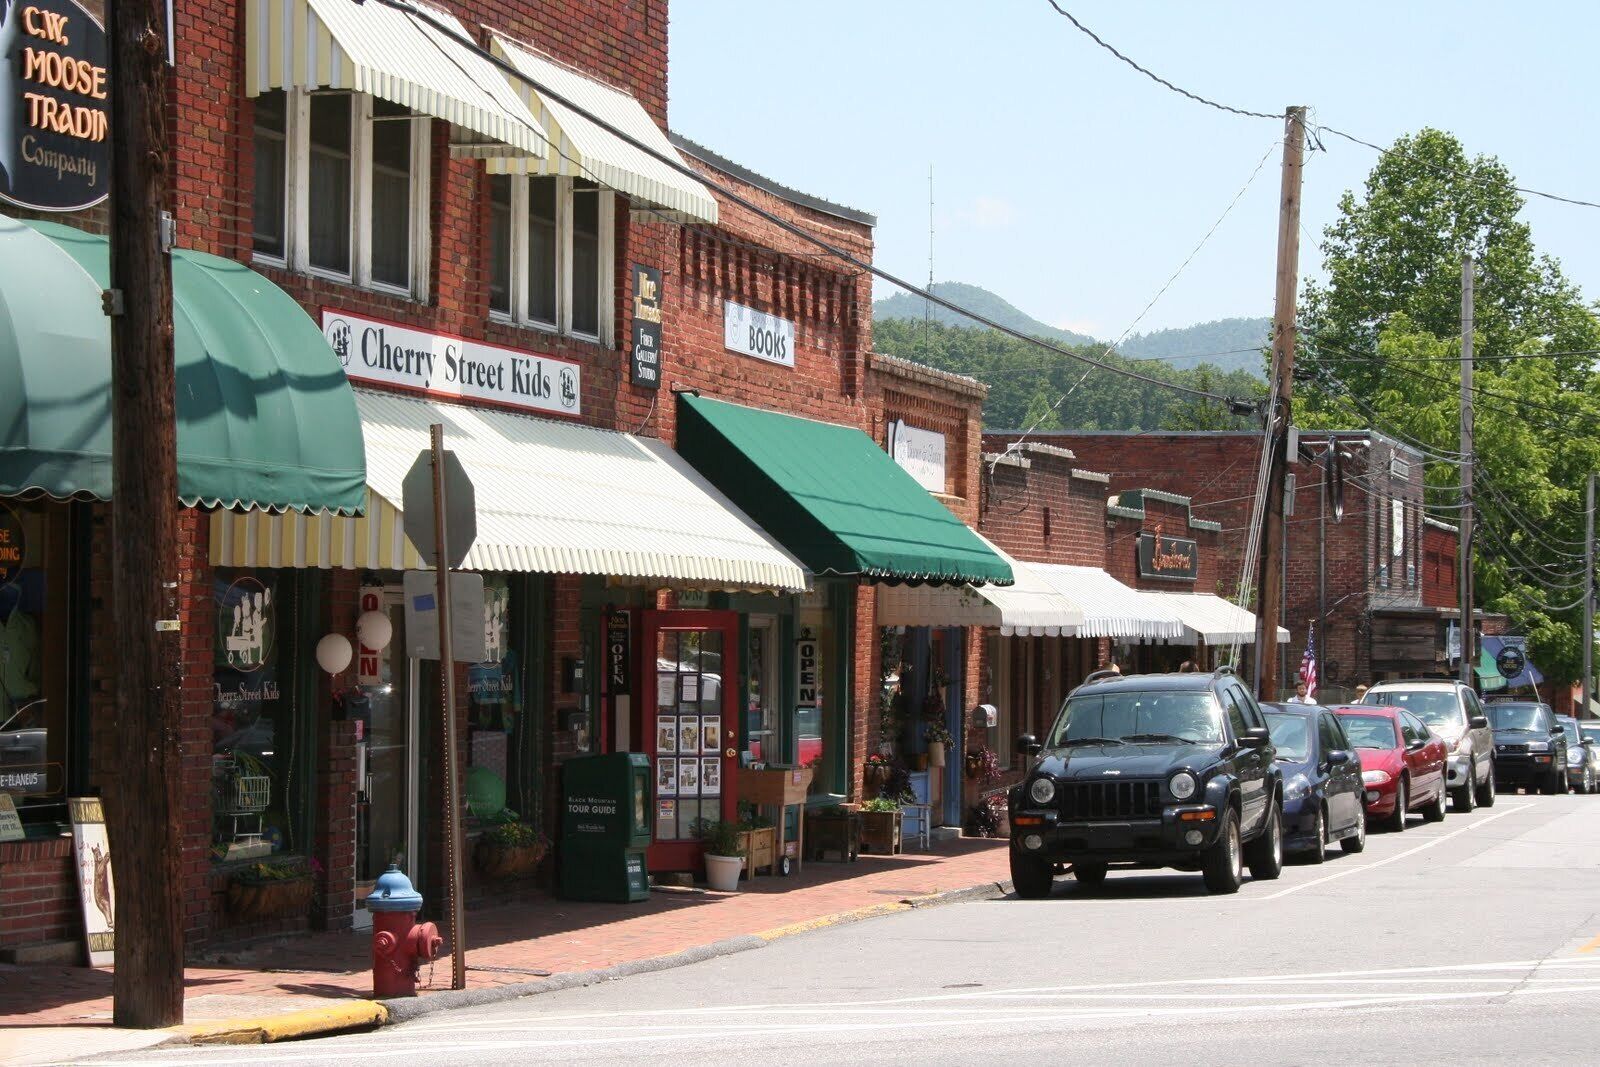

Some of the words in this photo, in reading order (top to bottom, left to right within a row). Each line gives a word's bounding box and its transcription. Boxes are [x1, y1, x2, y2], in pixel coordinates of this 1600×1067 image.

[22, 6, 69, 46] C.W.
[24, 47, 107, 100] MOOSE
[21, 134, 96, 187] Company
[361, 327, 436, 389] Cherry
[445, 344, 505, 392] Street
[510, 357, 551, 399] Kids
[749, 325, 786, 360] BOOKS
[360, 593, 378, 676] ON
[611, 644, 624, 685] OPEN
[800, 644, 815, 702] OPEN
[263, 680, 280, 700] Kids
[568, 804, 589, 814] TOUR
[591, 805, 617, 815] GUIDE
